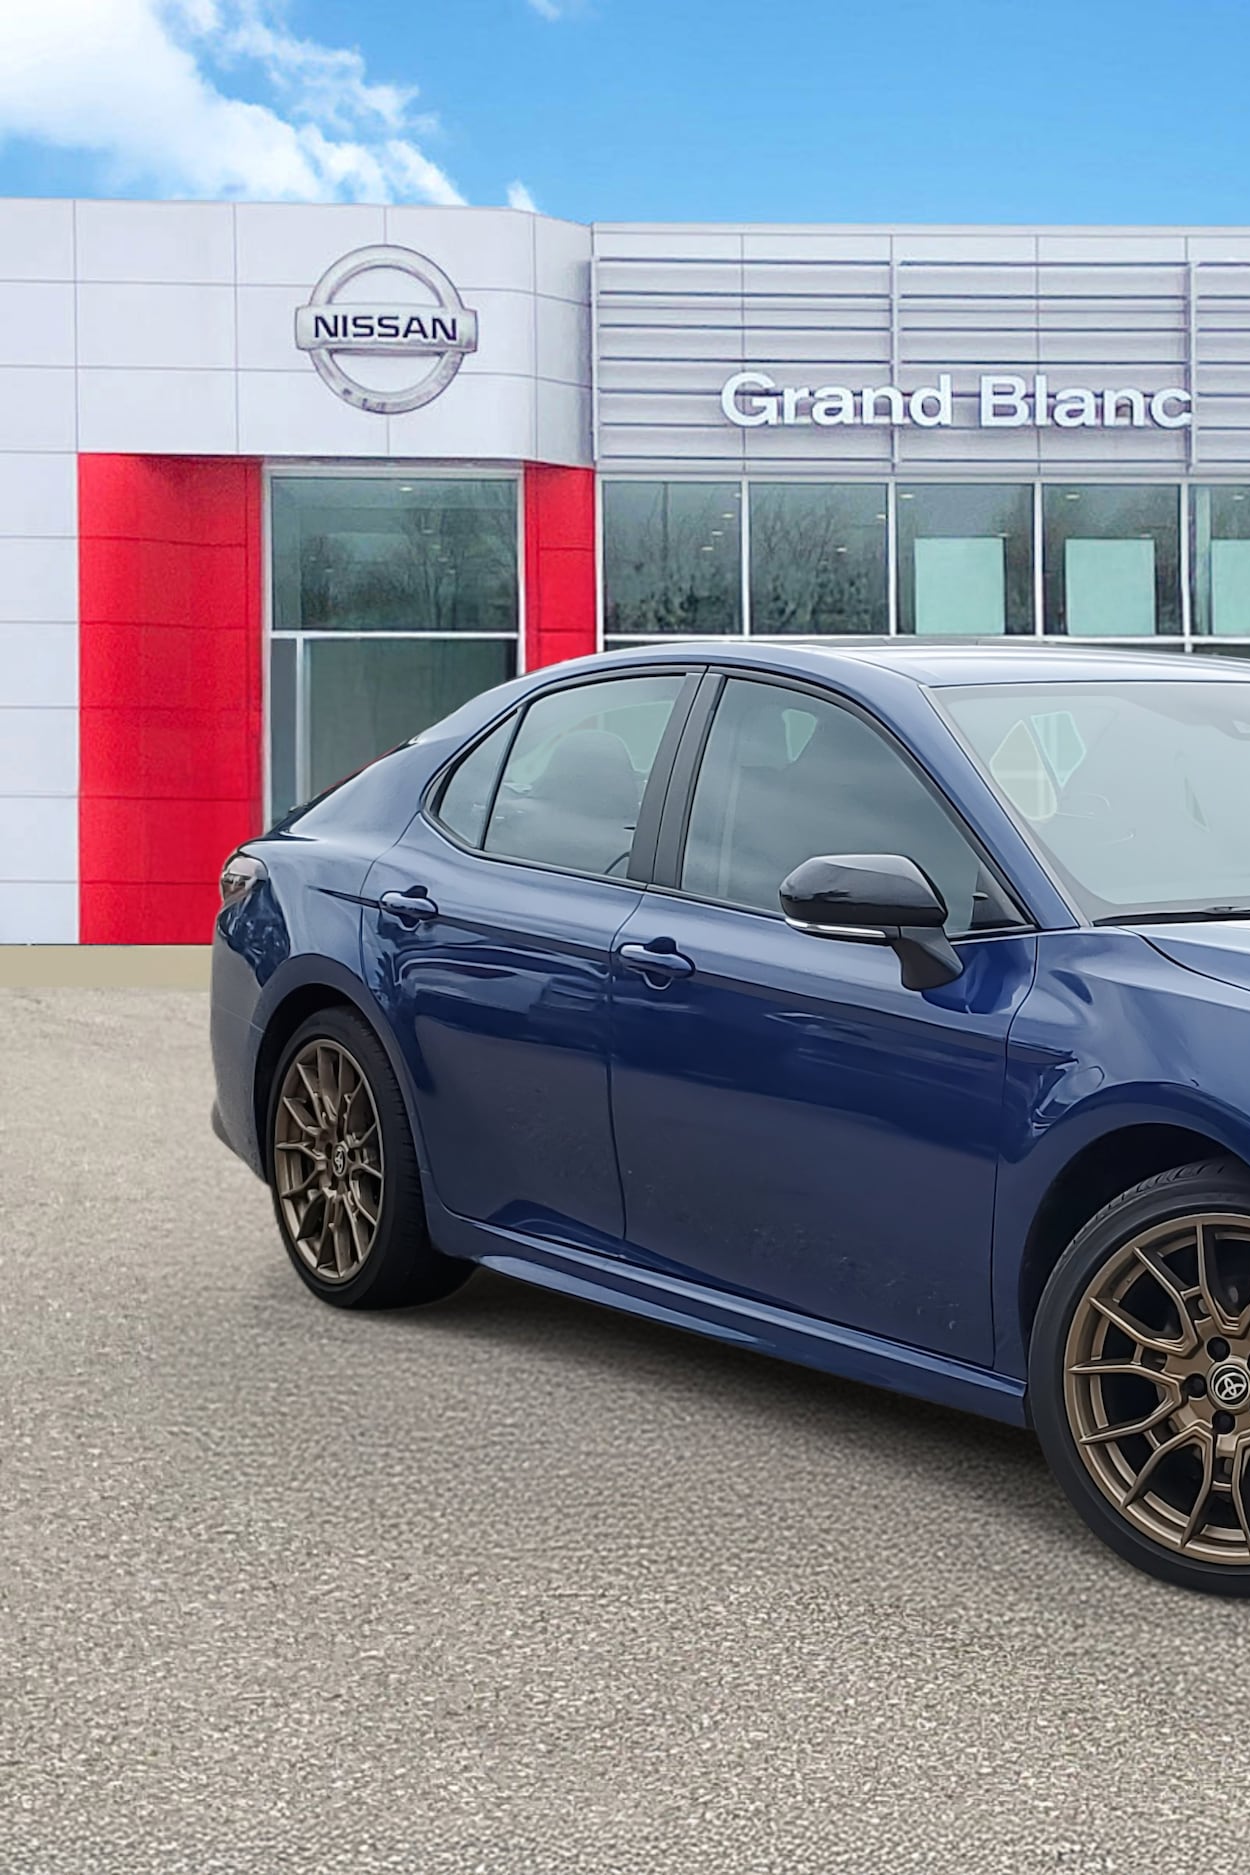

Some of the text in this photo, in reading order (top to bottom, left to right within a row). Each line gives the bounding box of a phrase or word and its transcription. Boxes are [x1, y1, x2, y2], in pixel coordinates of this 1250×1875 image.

[314, 315, 457, 341] NISSAN
[721, 371, 1193, 429] Grand Blanc
